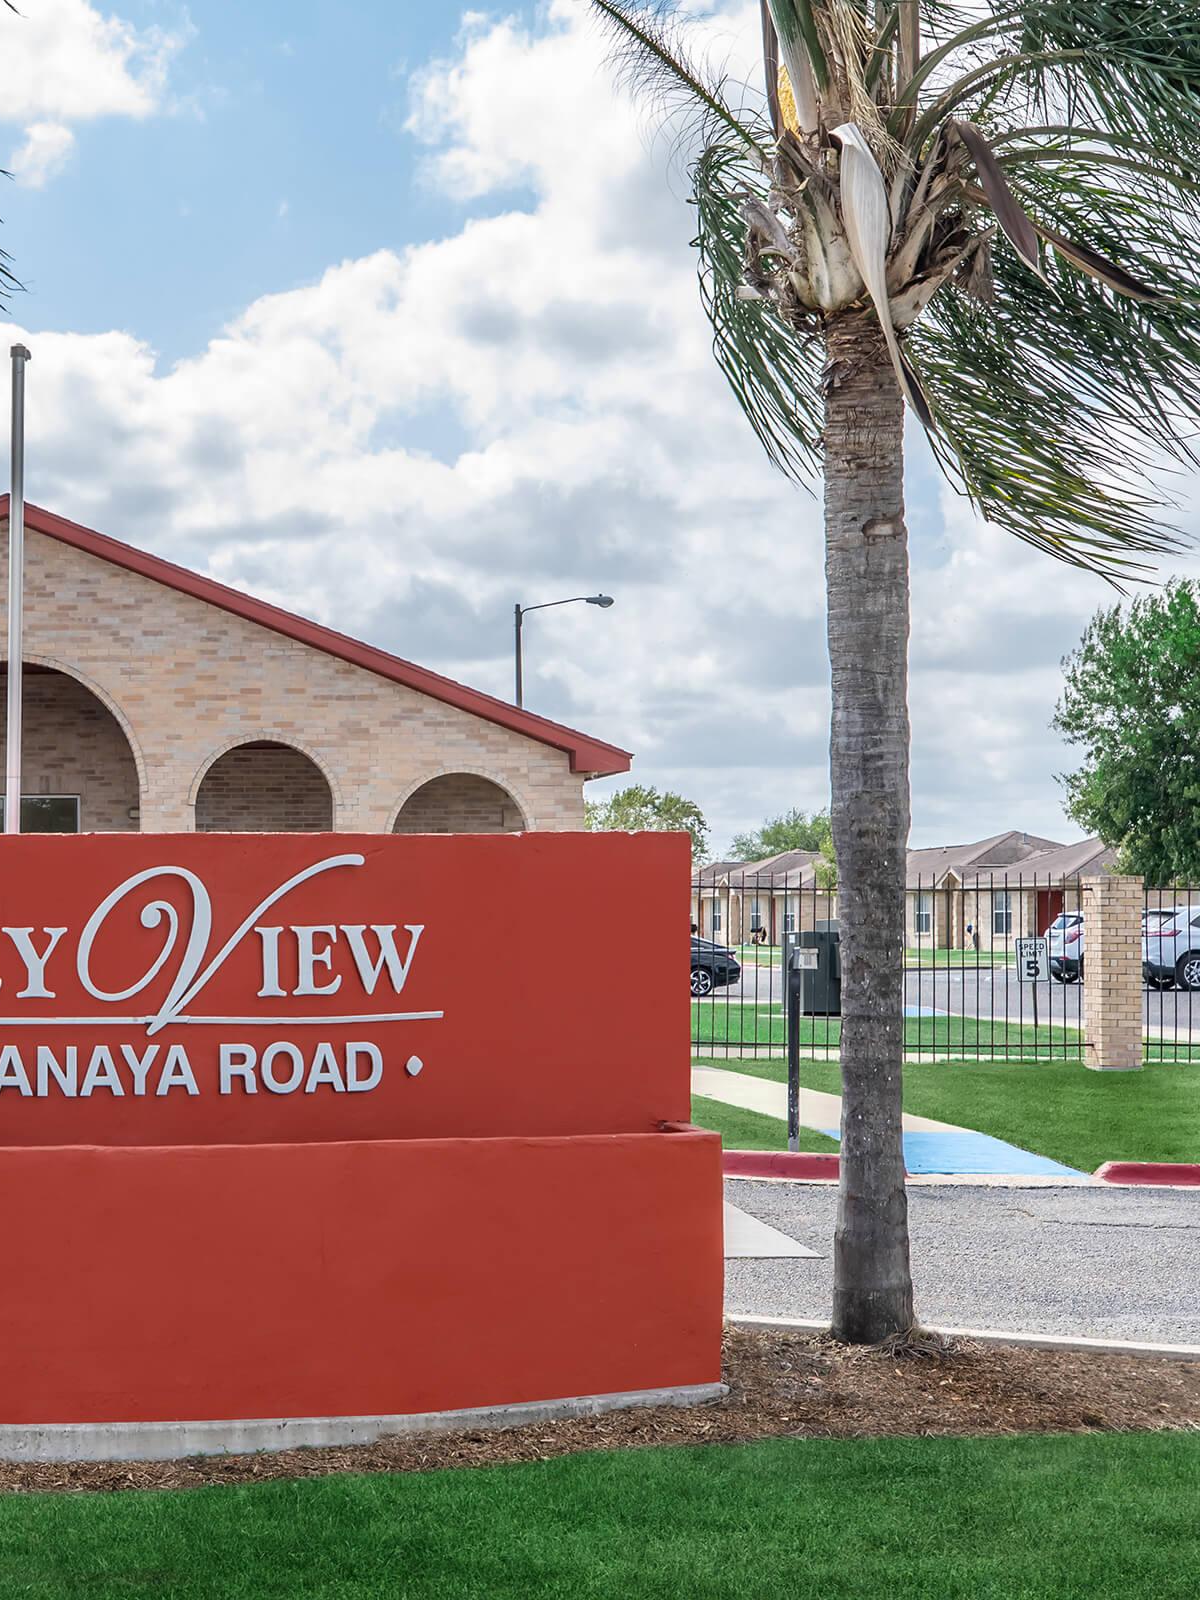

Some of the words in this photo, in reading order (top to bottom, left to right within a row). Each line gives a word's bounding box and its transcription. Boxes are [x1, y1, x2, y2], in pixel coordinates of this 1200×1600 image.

[78, 854, 425, 1035] VIEW
[1026, 960, 1040, 977] 5
[220, 1042, 383, 1094] ROAD
